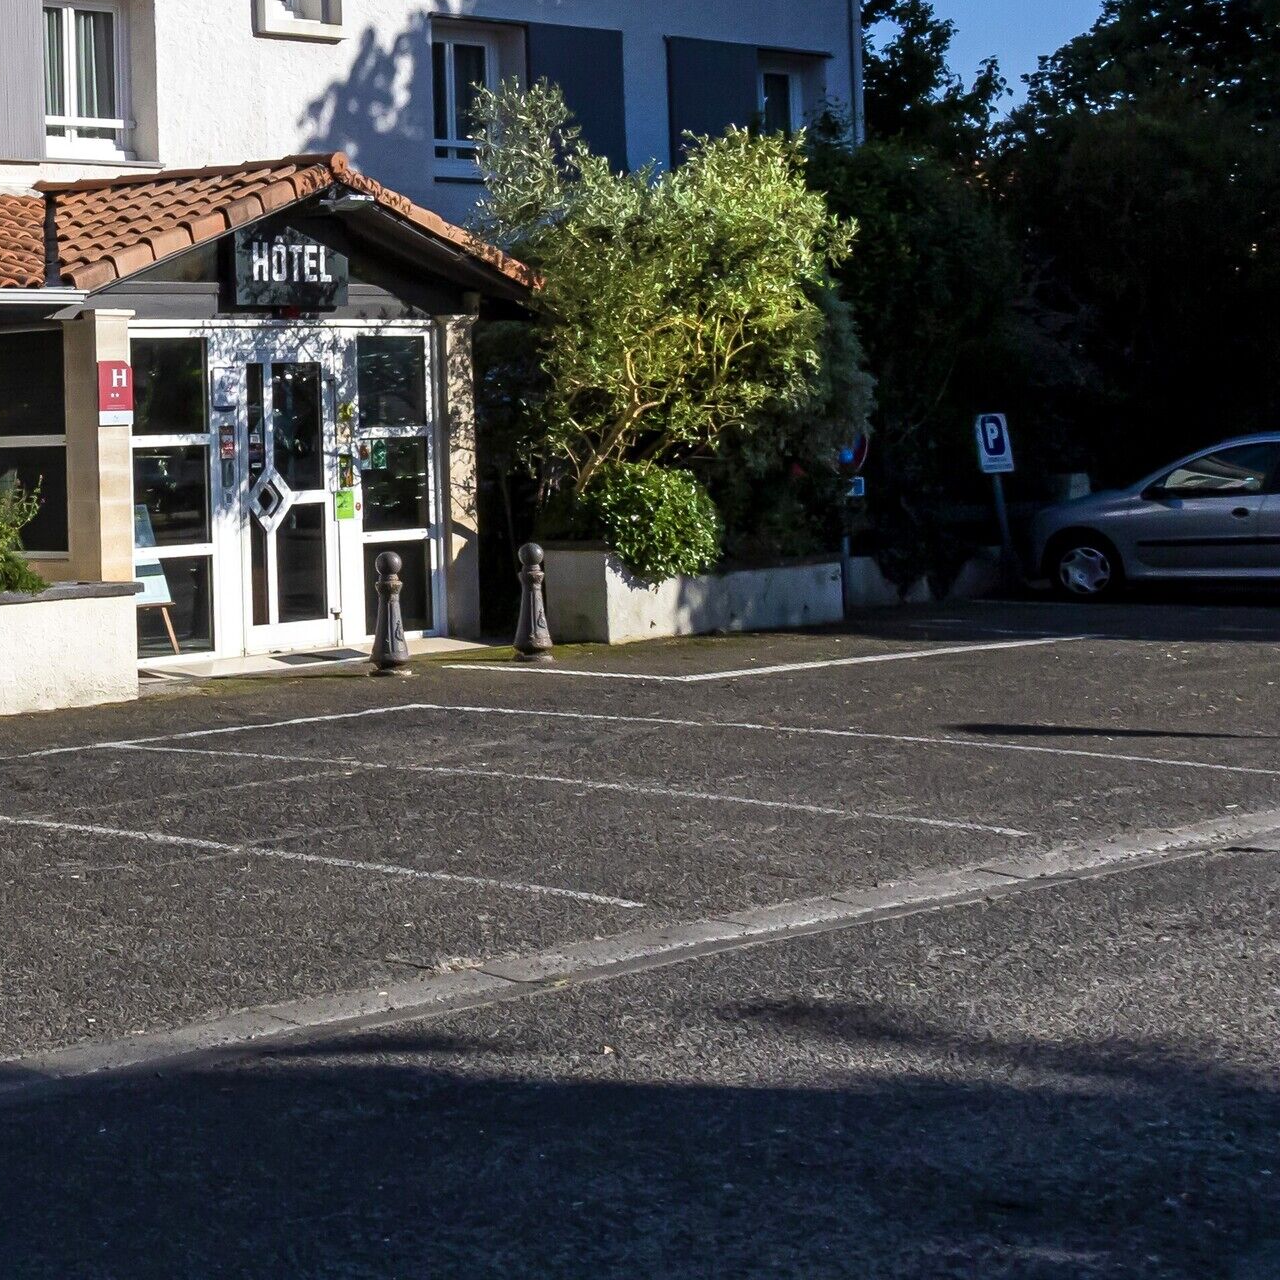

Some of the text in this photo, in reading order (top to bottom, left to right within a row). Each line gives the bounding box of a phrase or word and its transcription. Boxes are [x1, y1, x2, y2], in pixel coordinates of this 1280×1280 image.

[252, 235, 332, 282] HÔTEL
[111, 368, 128, 388] H
[985, 423, 999, 449] P
